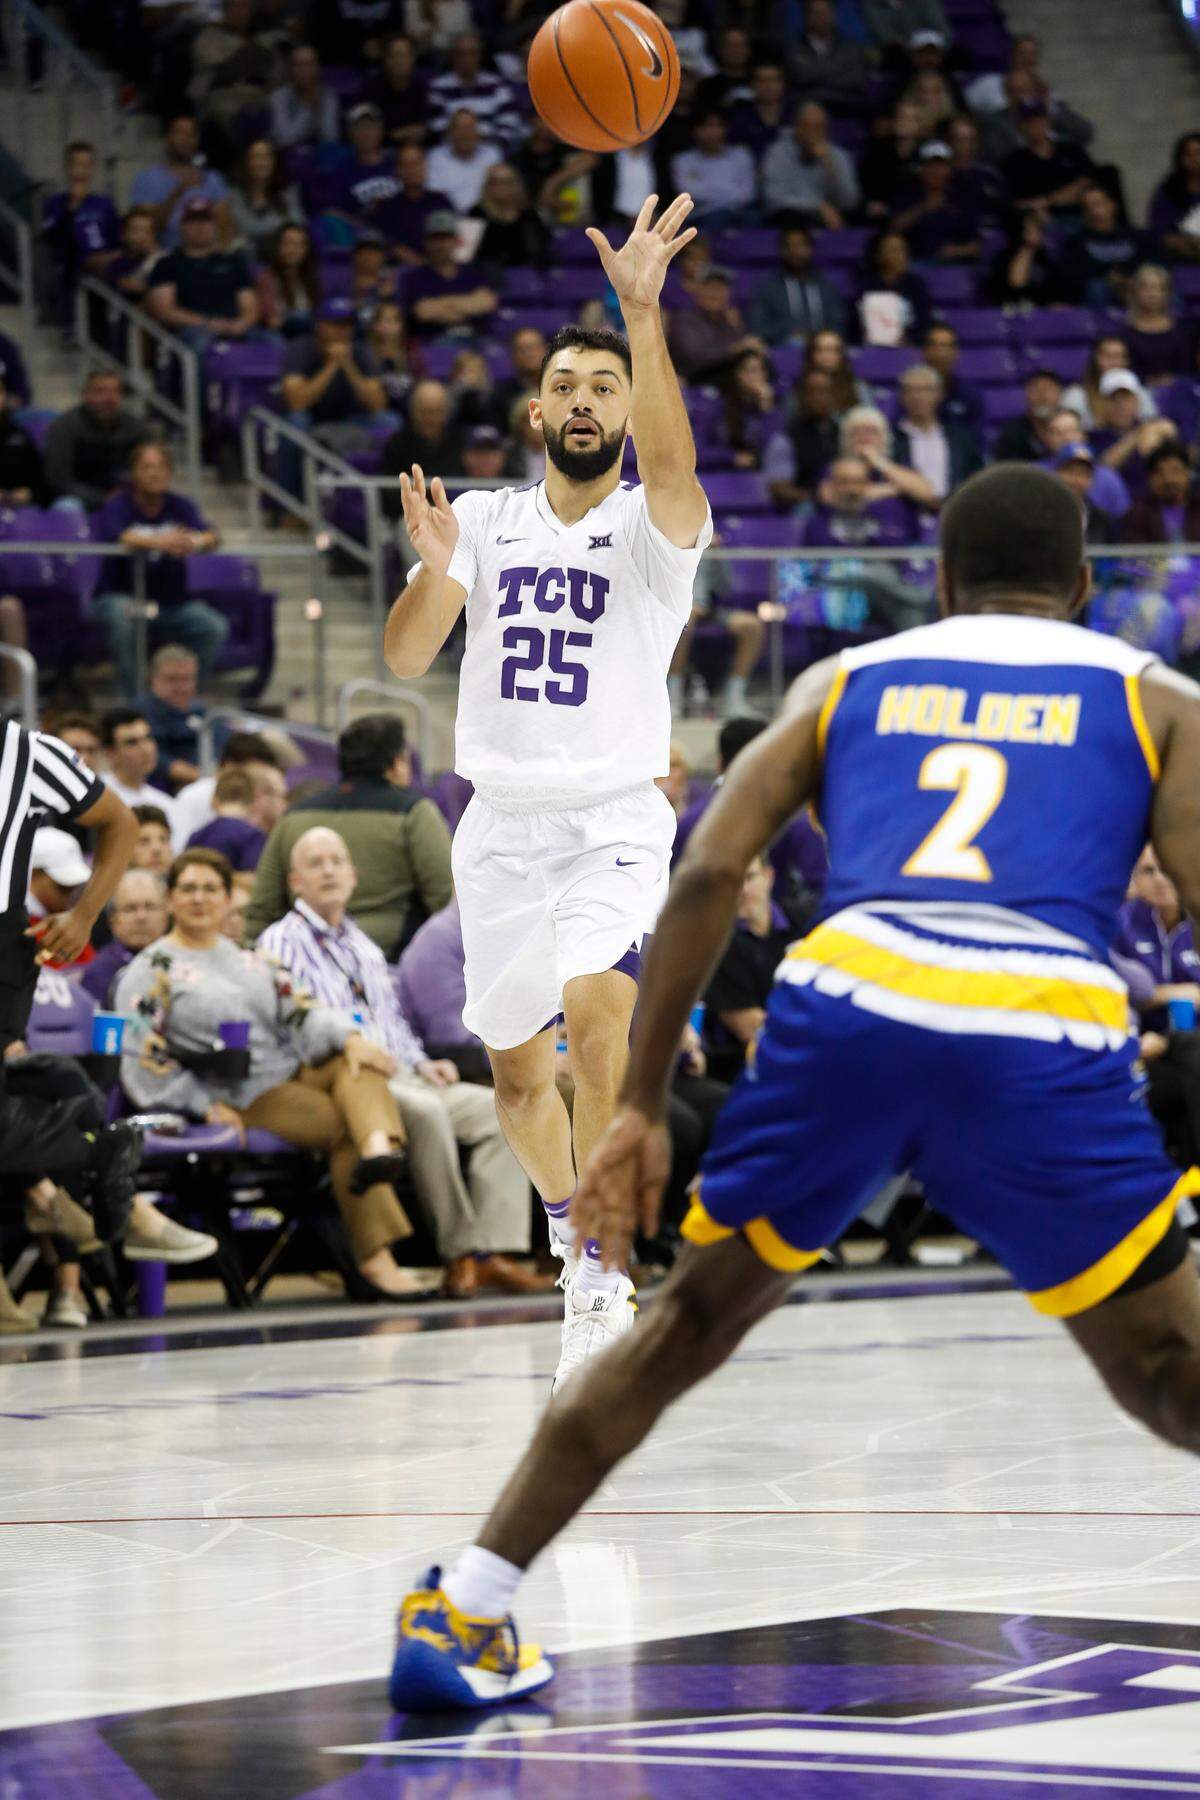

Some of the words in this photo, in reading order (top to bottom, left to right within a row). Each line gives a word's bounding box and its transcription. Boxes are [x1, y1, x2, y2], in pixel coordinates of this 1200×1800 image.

[497, 566, 610, 624] TCU
[500, 626, 593, 707] 25
[875, 684, 1082, 747] HOLDEN
[900, 741, 1008, 883] 2
